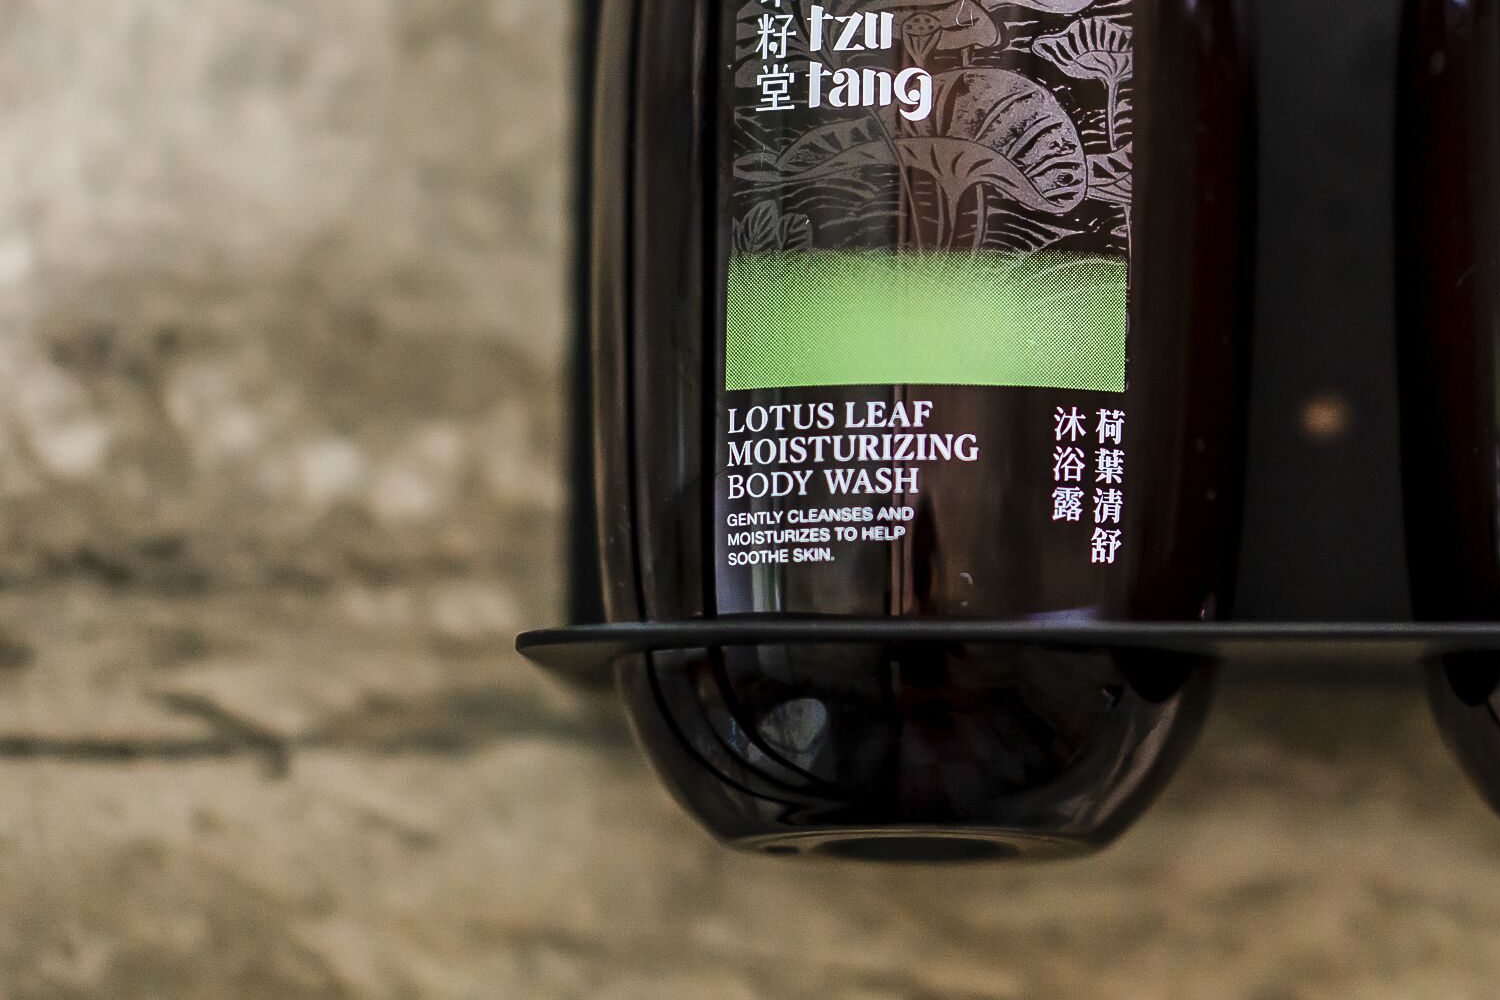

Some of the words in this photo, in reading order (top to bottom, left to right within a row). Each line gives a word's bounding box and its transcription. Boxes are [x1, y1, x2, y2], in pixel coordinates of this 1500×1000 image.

[807, 5, 895, 51] tzu
[806, 61, 933, 122] tang
[727, 402, 835, 435] LOTUS
[844, 400, 934, 429] LEAF
[727, 433, 980, 467] MOISTURIZING
[1051, 406, 1087, 522] 沐浴露
[727, 469, 812, 500] BODY
[823, 467, 920, 495] WASH
[1091, 408, 1126, 564] 荷葉清舒
[727, 510, 784, 527] GENTLY
[787, 507, 874, 524] CLEANSES
[877, 506, 915, 521] AND
[727, 528, 831, 547] MOISTURIZES
[834, 526, 858, 542] TO
[861, 526, 906, 541] HELP
[727, 548, 789, 567] SOOTHE
[792, 547, 836, 563] SKIN.
